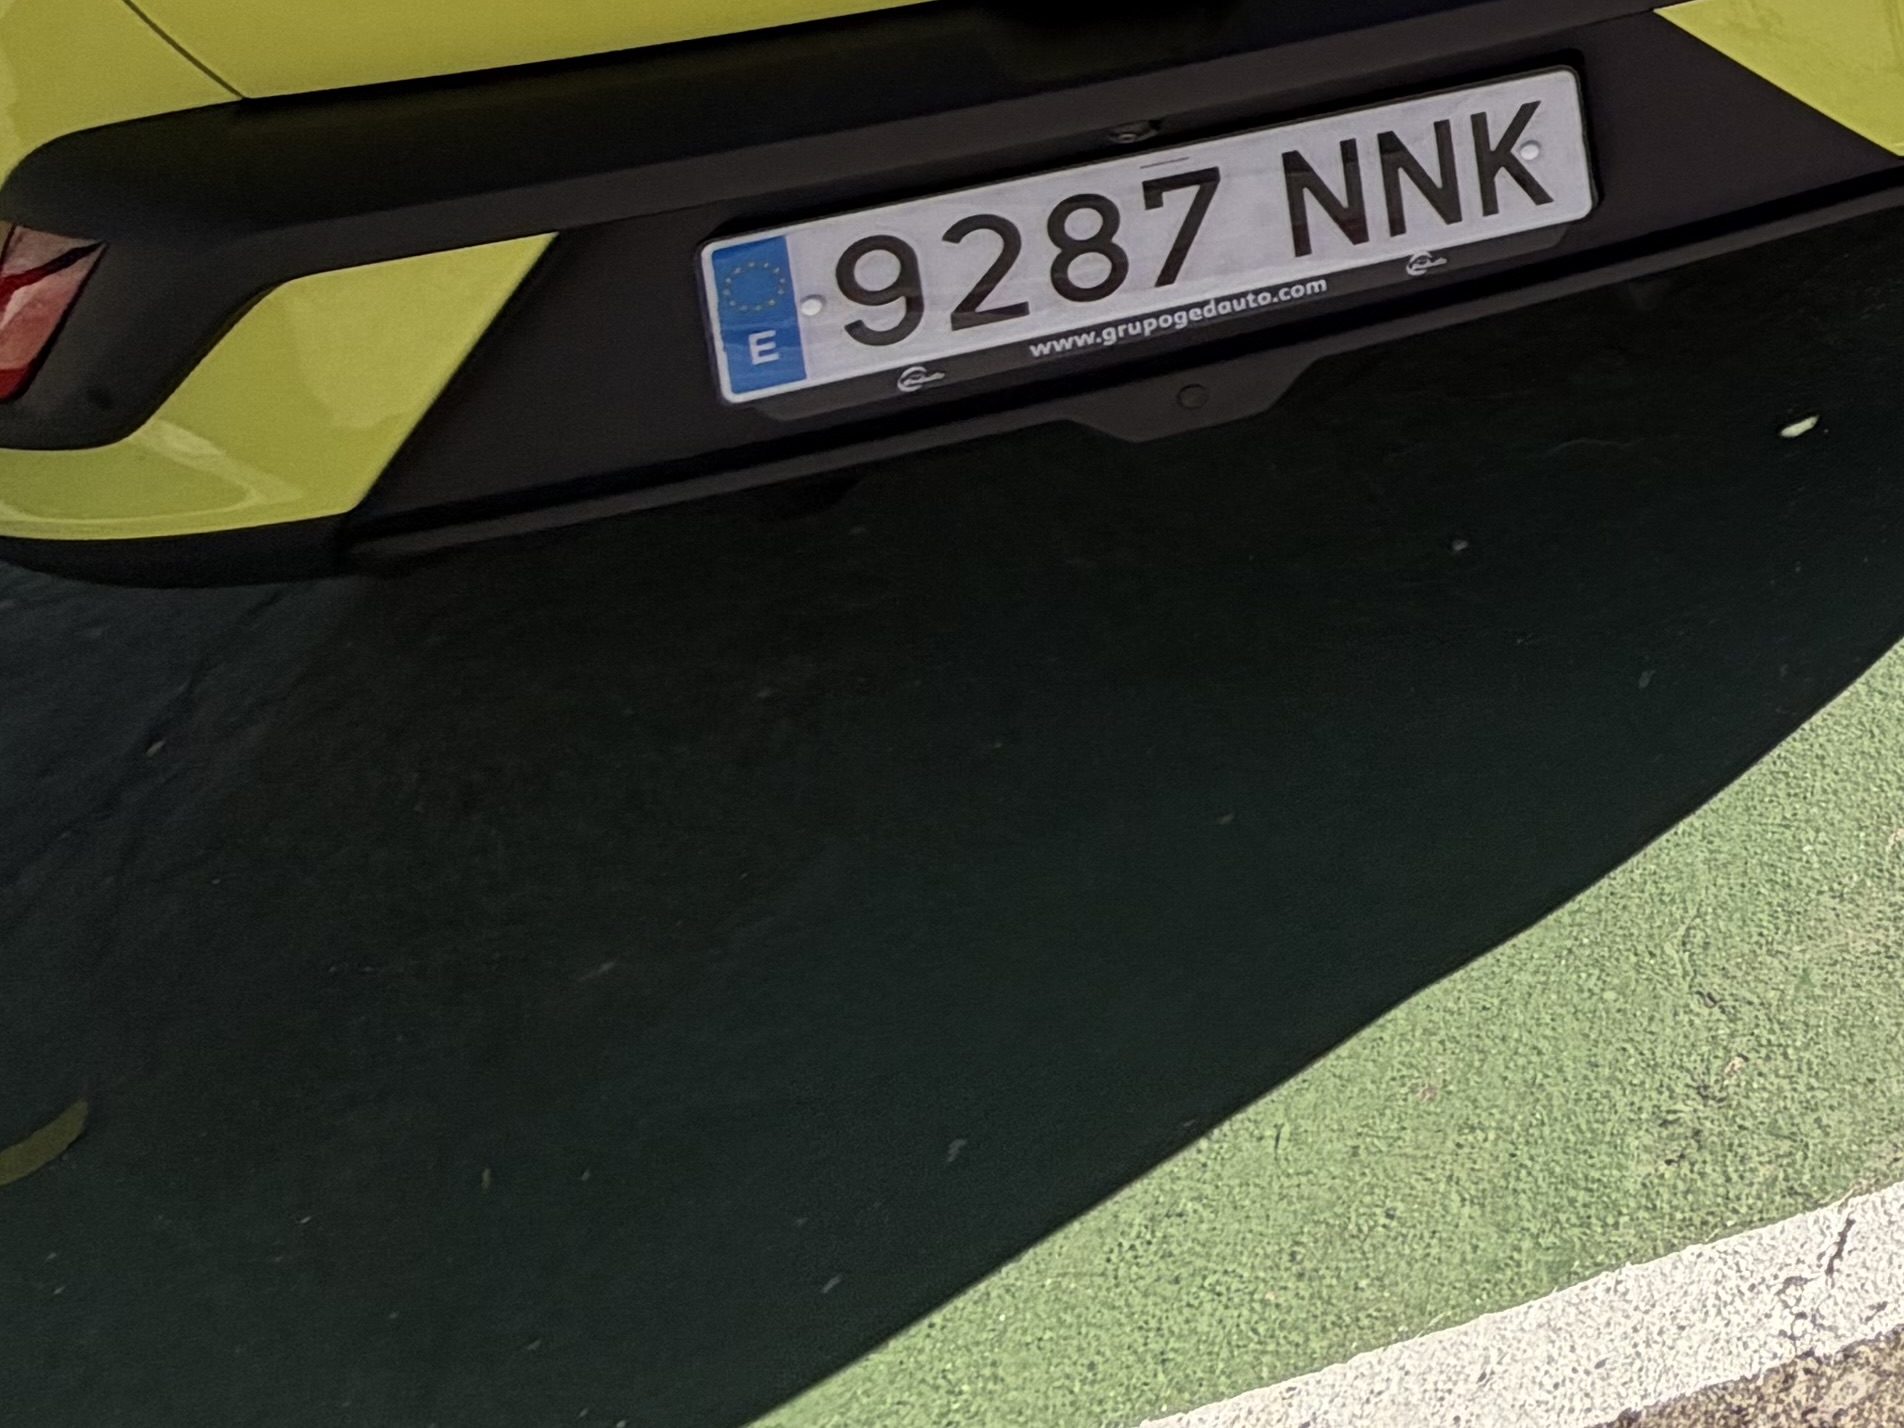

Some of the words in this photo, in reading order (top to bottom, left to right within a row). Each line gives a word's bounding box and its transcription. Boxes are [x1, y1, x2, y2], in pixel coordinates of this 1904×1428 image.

[834, 166, 1222, 347] 9287
[1281, 99, 1555, 259] NNK
[749, 330, 781, 363] E
[1029, 278, 1328, 357] www.grupogedauto.com
